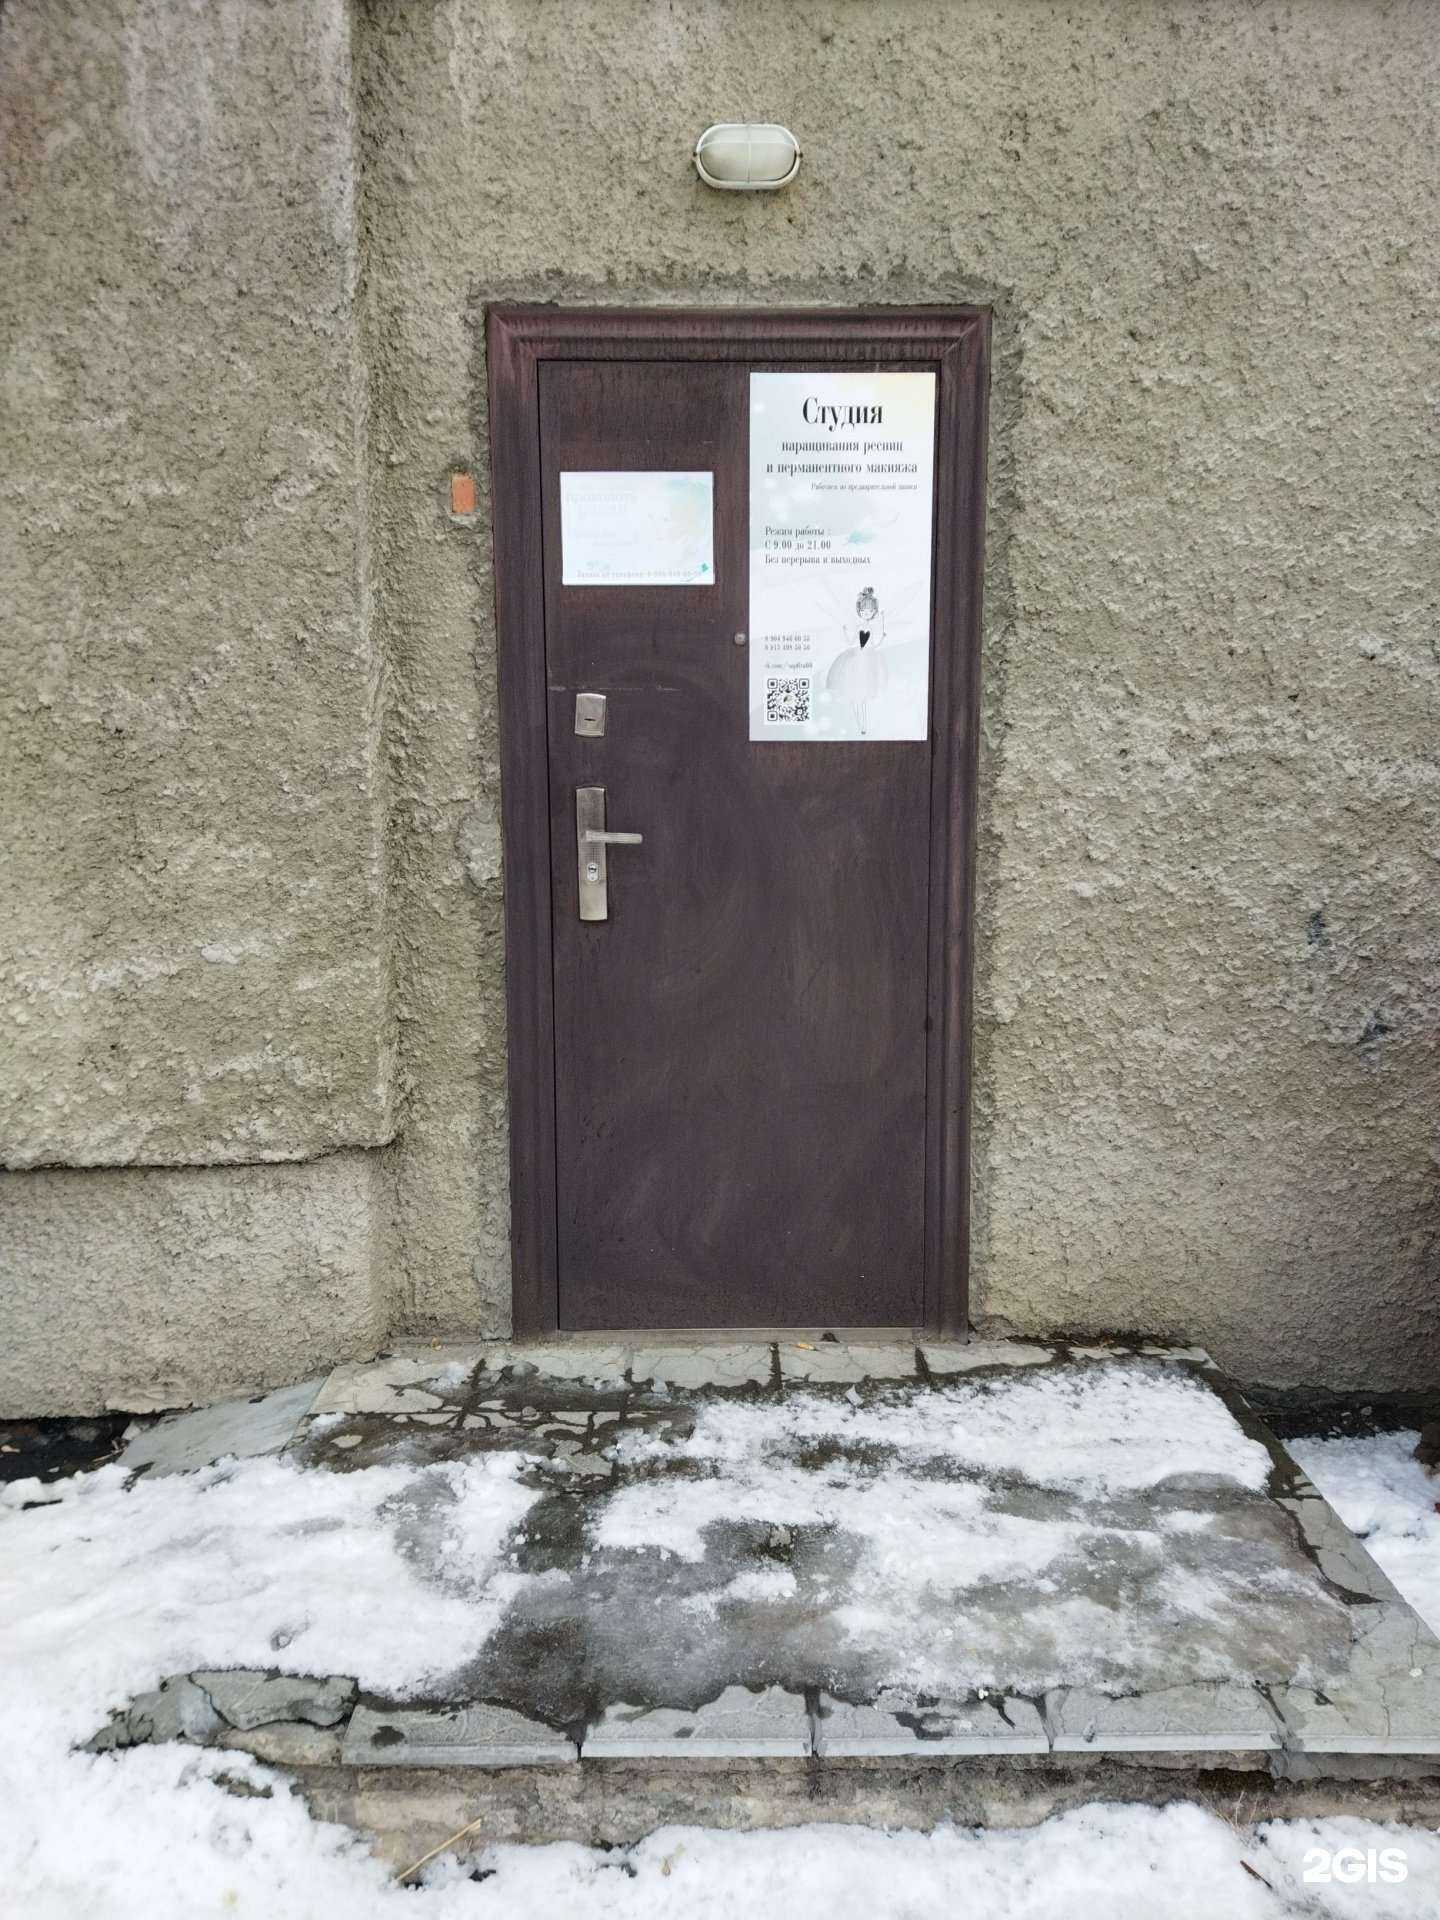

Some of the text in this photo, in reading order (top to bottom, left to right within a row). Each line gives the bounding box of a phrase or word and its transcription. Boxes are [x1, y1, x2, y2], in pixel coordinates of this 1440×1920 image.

[803, 397, 883, 431] Студия
[781, 441, 903, 455] наращивания ресниц
[766, 463, 918, 477] и перманентного макияжа
[765, 526, 792, 536] Режим
[795, 525, 825, 538] работы
[773, 540, 792, 550] 9.00
[807, 540, 831, 550] 21.00
[765, 554, 779, 564] Без
[781, 556, 820, 566] перерыва
[831, 556, 871, 565] выходных
